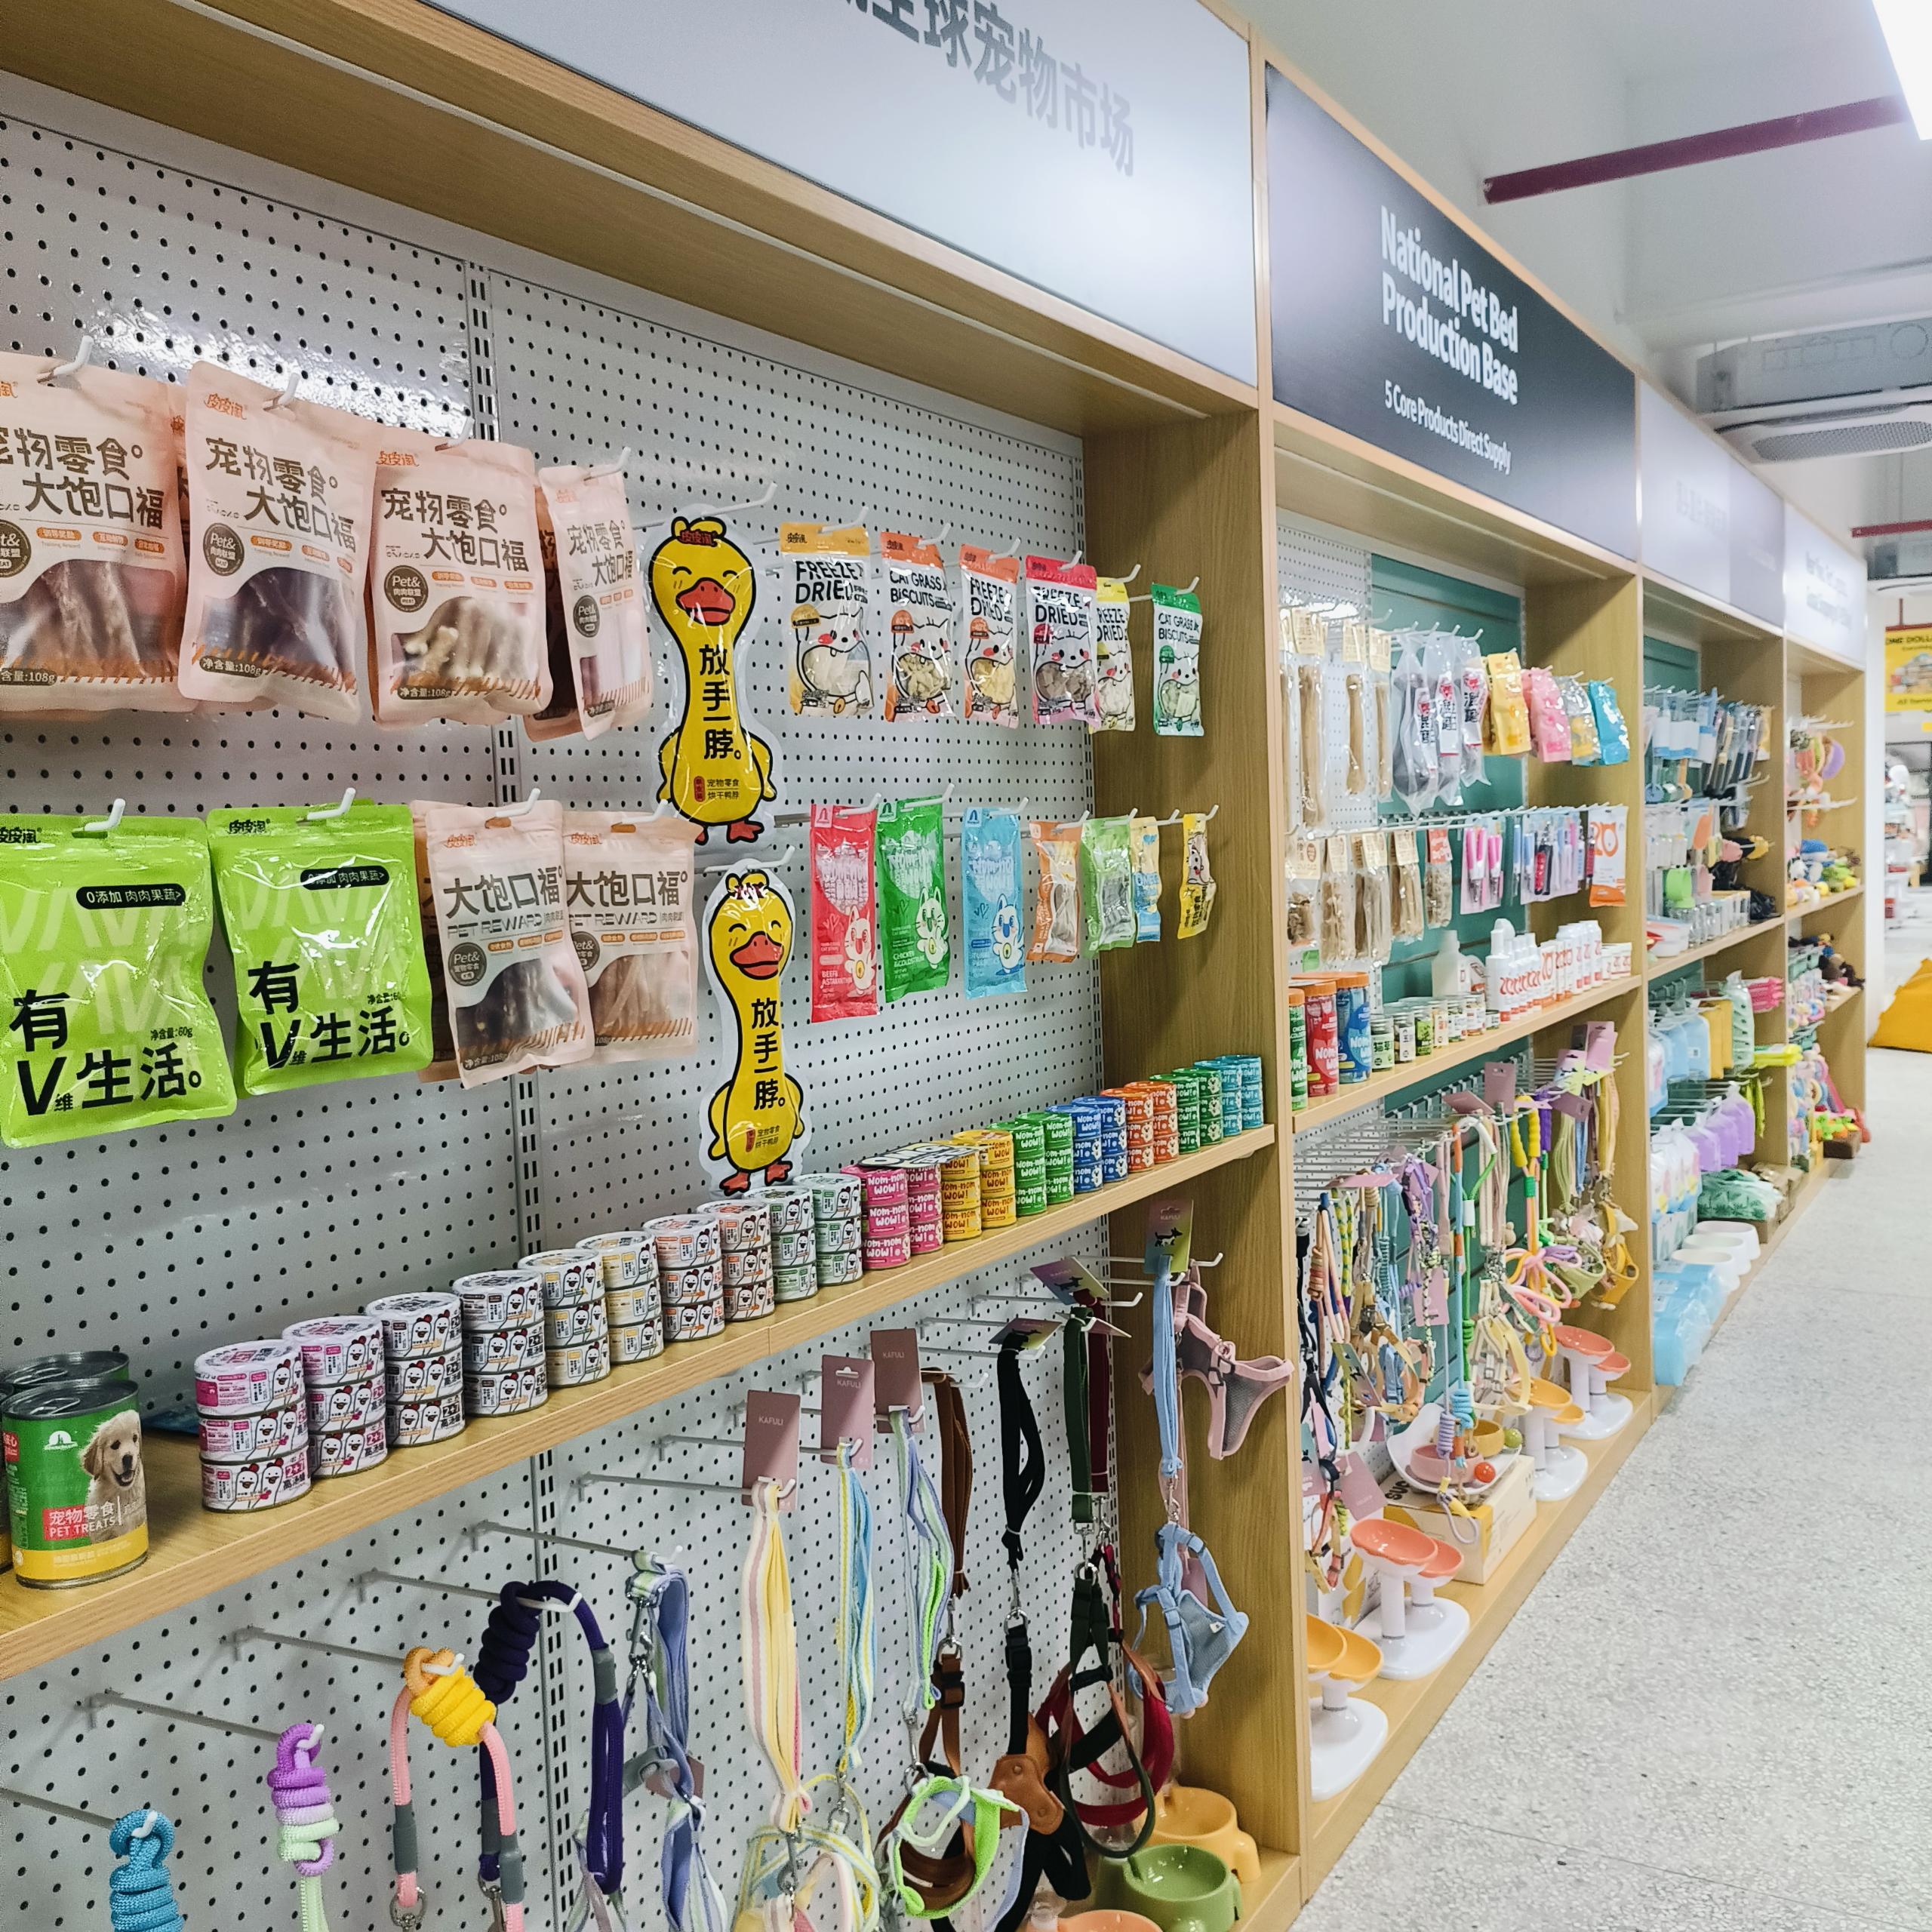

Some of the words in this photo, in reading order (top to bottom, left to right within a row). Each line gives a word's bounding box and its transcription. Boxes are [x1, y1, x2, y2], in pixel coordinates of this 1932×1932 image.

[1381, 205, 1460, 312] National
[1461, 269, 1489, 334] Pet
[1490, 291, 1518, 352] Bed
[1383, 270, 1481, 383] Production
[1482, 341, 1518, 405] Base
[1385, 380, 1393, 408] 5
[1393, 384, 1417, 423] Core
[1418, 397, 1458, 444] Products
[1459, 420, 1484, 457] Direct
[1484, 433, 1512, 475] Supply
[23, 472, 165, 530] 大饱口福
[244, 485, 356, 552] 大饱口福
[211, 533, 236, 549] Pet&
[421, 528, 529, 572] 大饱口福
[392, 575, 421, 587] Pet&
[1035, 605, 1078, 626] DRIED
[1097, 608, 1125, 623] REEZE
[595, 912, 658, 926] REWARD
[454, 952, 481, 964] Pet&
[248, 960, 301, 1015] 有
[9, 988, 71, 1052] 有
[882, 1351, 905, 1359] KAFULI
[837, 1379, 862, 1389] KAFULI
[758, 1416, 784, 1426] KAFULI
[49, 1500, 115, 1526] 宠物零食
[50, 1526, 71, 1538] PET
[75, 1515, 116, 1534] TREATS
